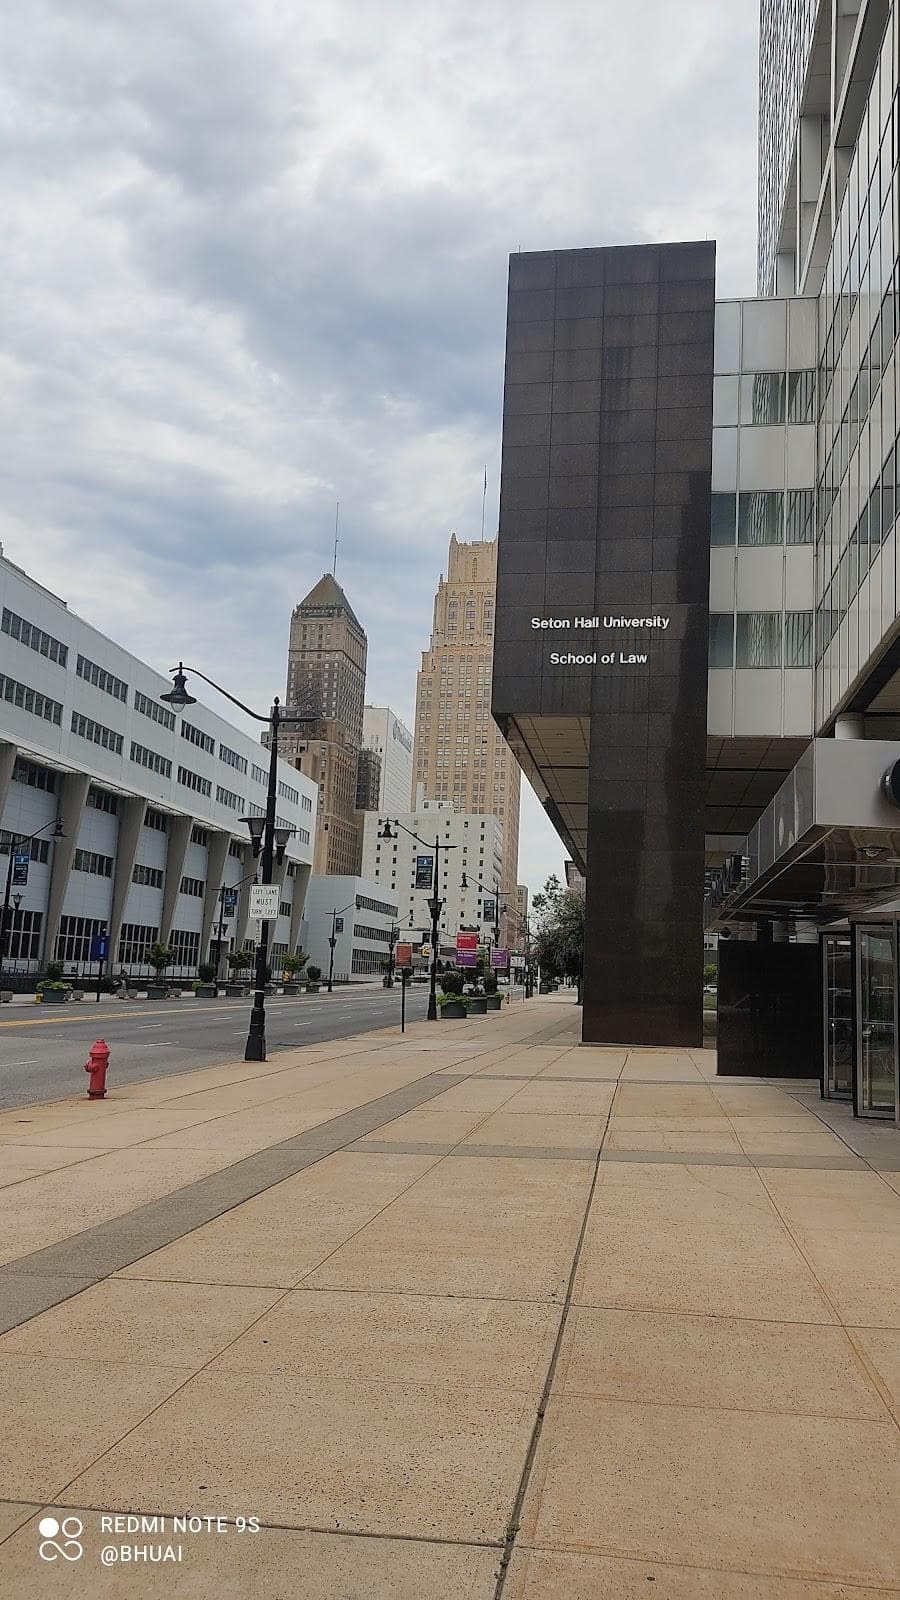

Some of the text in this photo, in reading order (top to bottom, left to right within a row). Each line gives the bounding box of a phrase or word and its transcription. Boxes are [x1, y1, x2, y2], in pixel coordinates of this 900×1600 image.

[531, 615, 670, 629] Seton Hall University
[550, 652, 648, 664] School of Law
